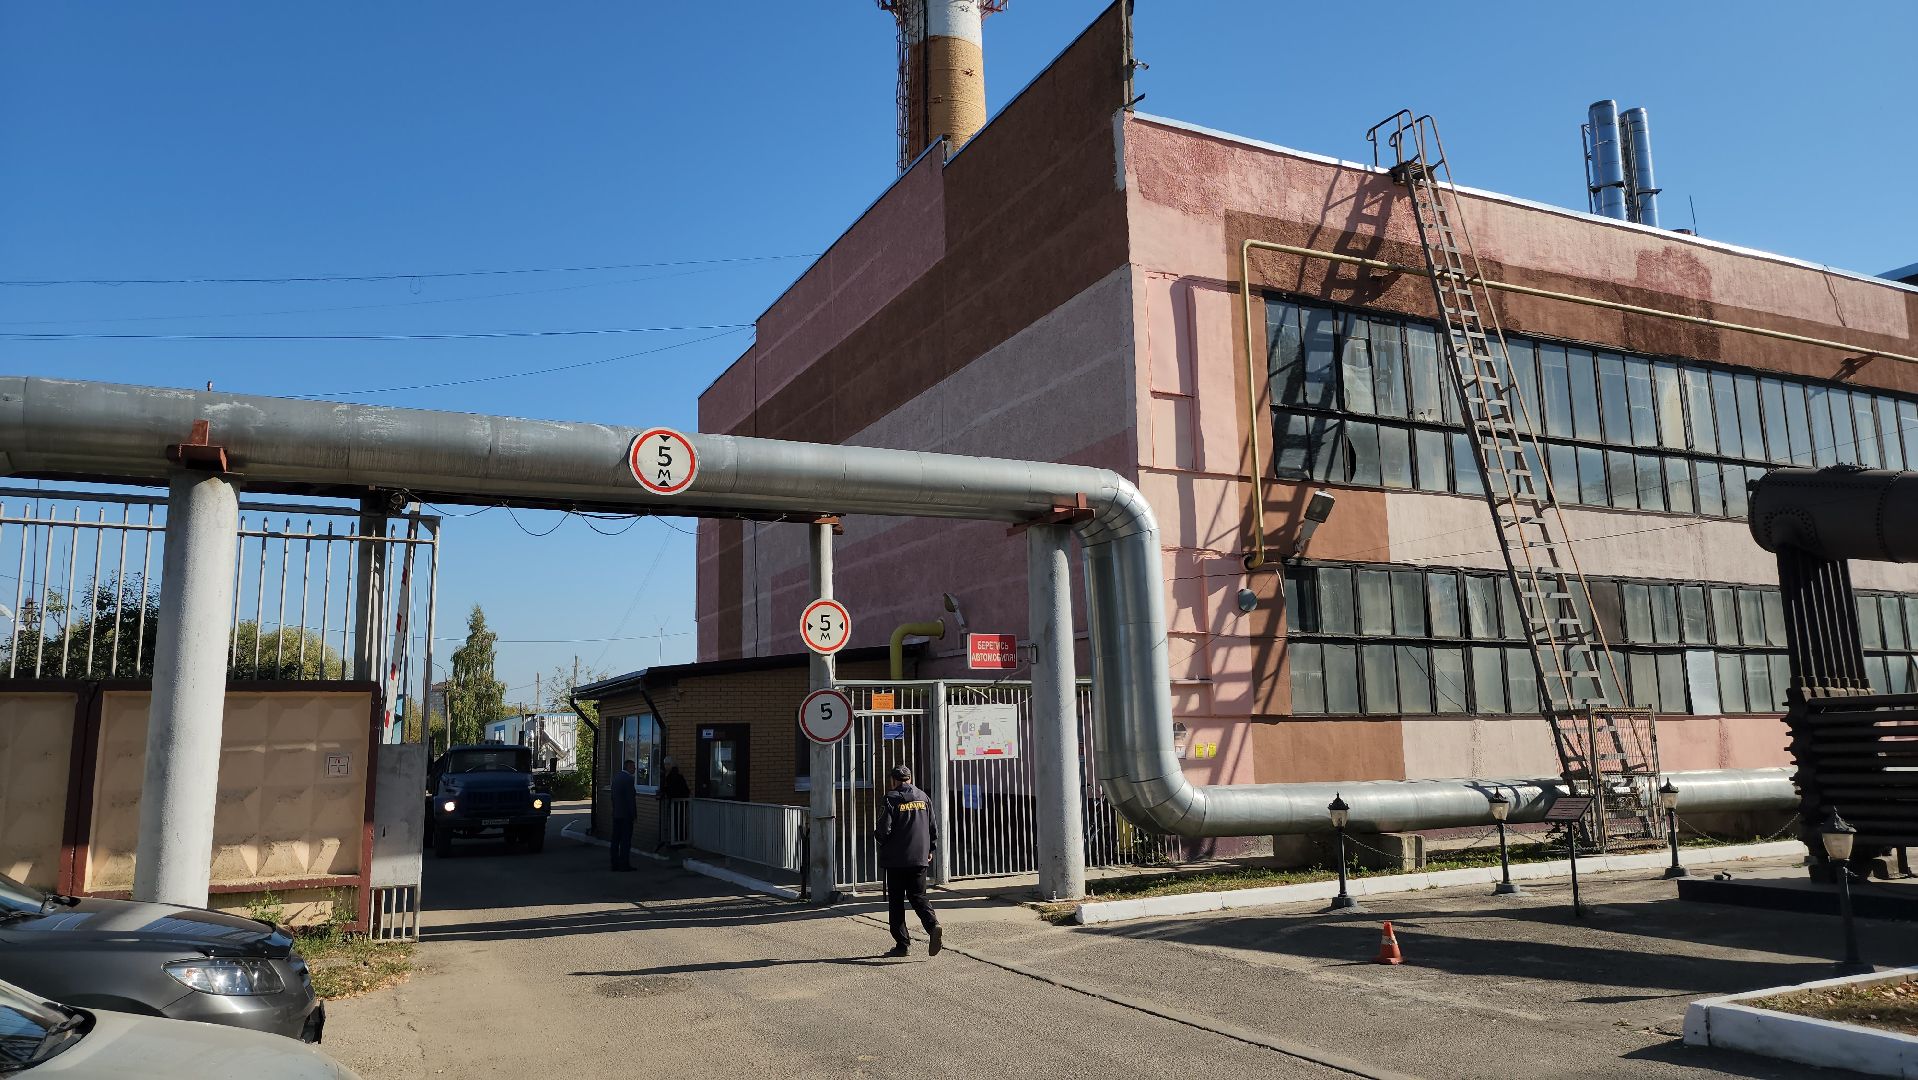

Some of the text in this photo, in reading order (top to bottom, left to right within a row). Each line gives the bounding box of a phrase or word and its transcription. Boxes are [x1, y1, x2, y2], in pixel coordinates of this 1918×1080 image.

[657, 445, 673, 467] 5
[819, 614, 831, 631] 5
[977, 640, 1009, 650] БЕРЕГИСЬ
[972, 652, 1016, 662] АВТОМОБИЛЯ!
[820, 702, 833, 721] 5
